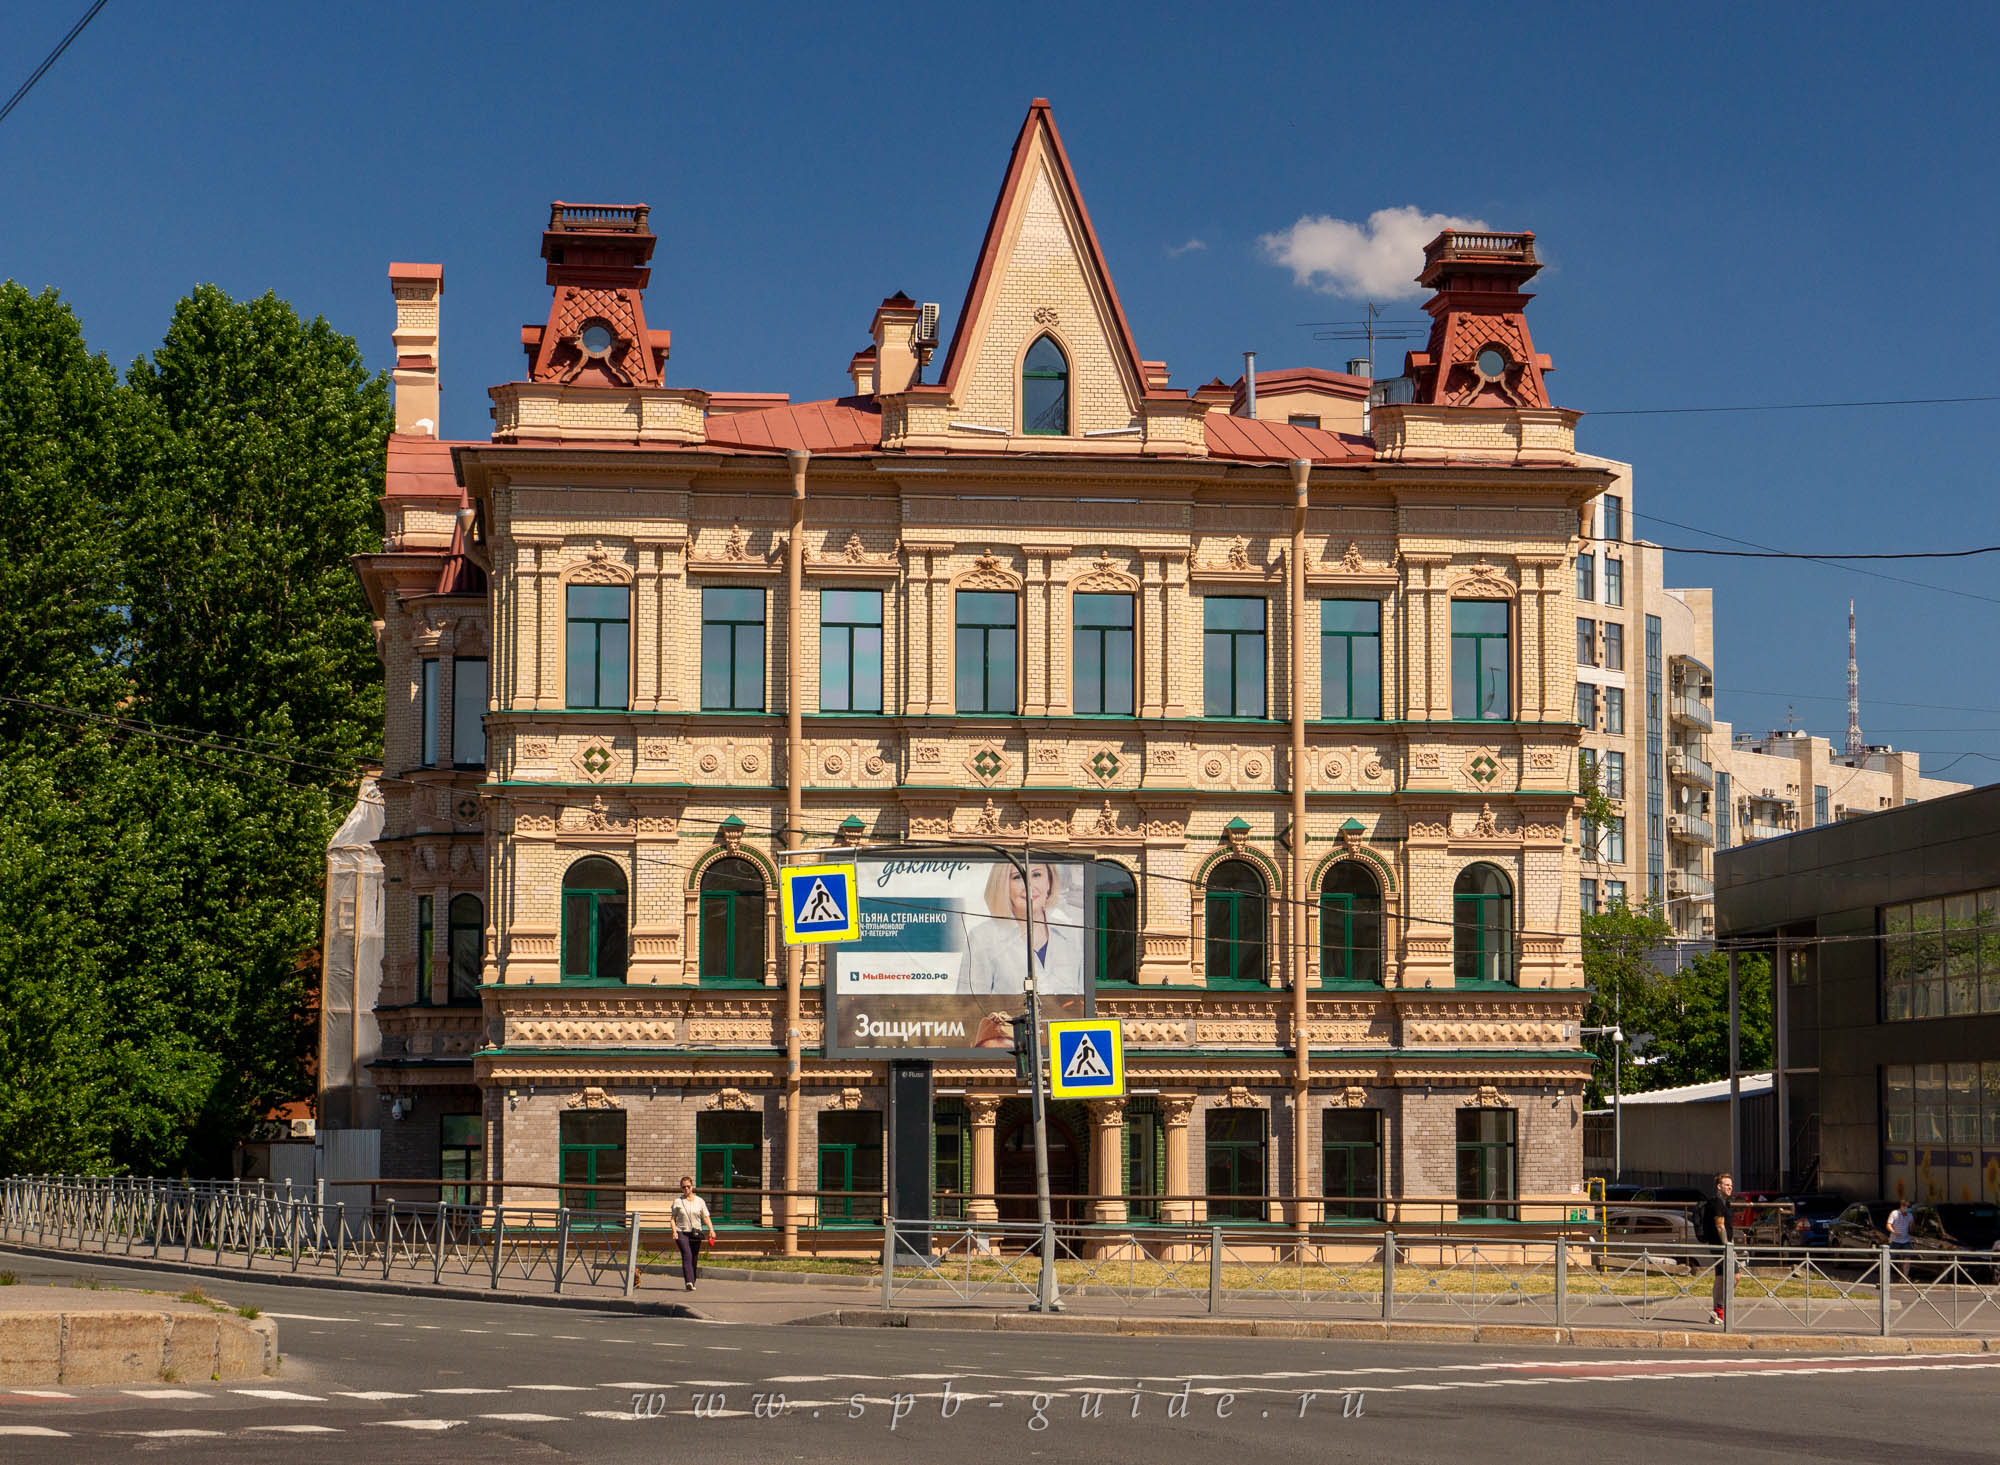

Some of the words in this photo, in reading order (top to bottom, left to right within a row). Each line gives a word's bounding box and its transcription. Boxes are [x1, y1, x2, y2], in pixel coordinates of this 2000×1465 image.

[860, 912, 889, 923] ТЬЯНА
[891, 912, 947, 924] СТЕПАНЕНКО
[863, 972, 948, 981] МыВместе2020.РФ
[854, 1013, 966, 1042] Защитим
